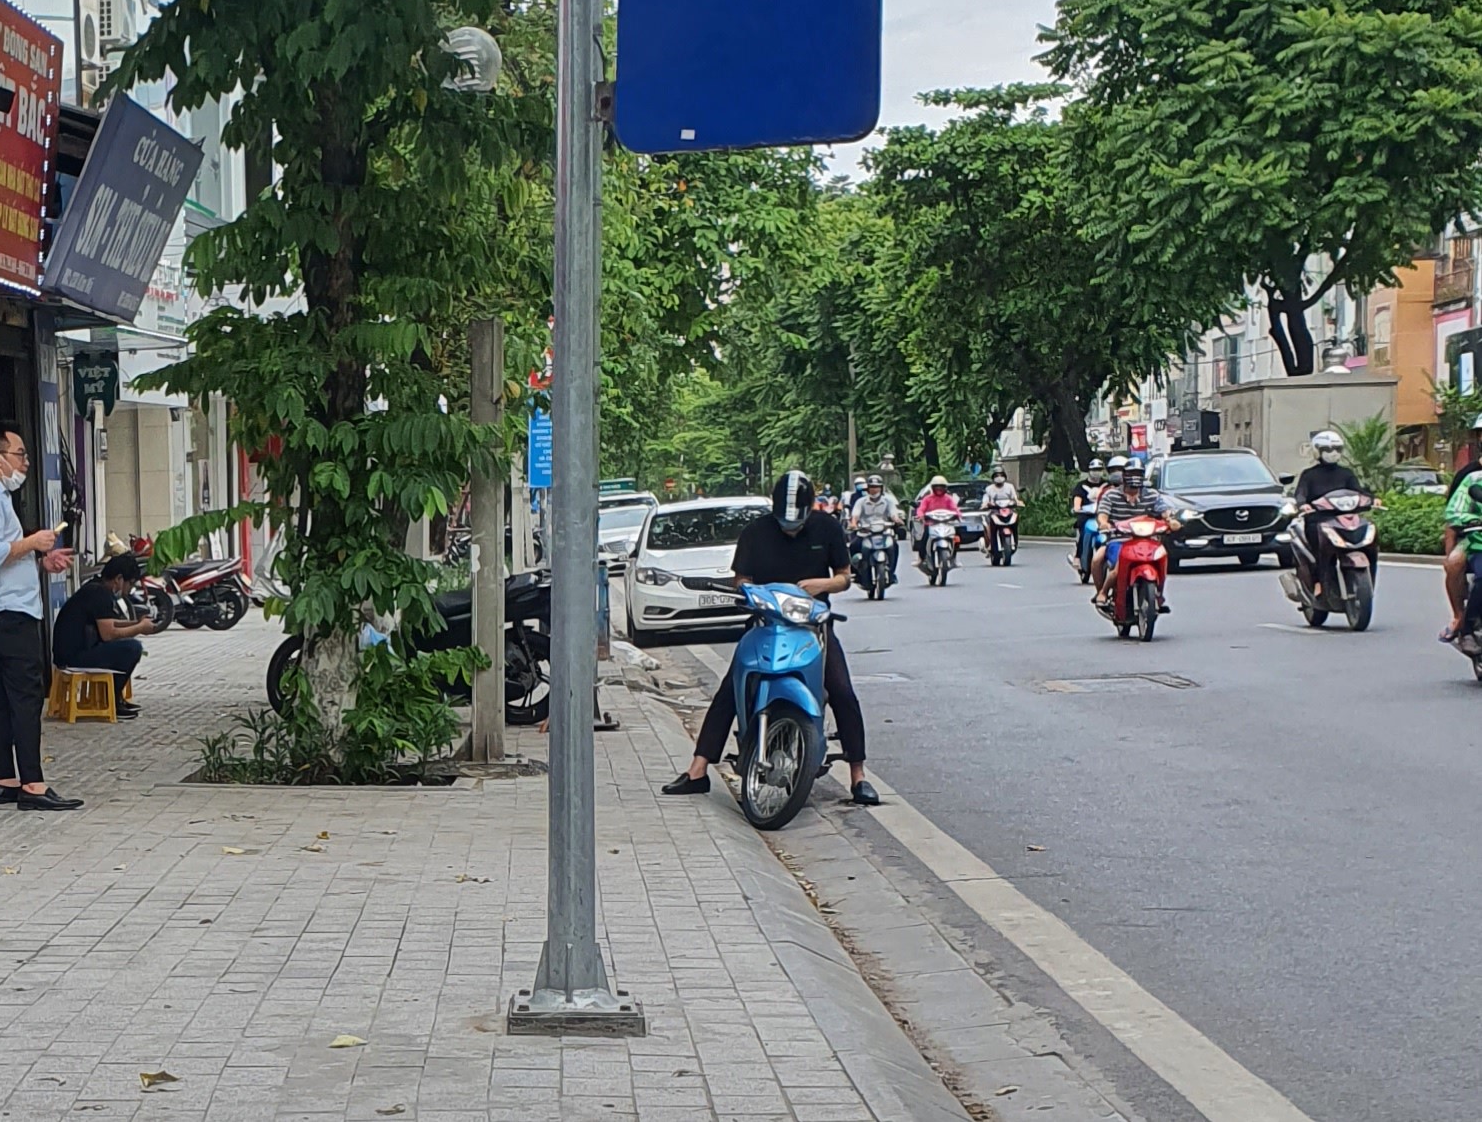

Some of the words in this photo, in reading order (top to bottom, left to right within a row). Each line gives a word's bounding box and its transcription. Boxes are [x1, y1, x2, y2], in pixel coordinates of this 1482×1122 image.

[3, 25, 29, 66] ĐỘNG
[29, 40, 49, 79] SẢN
[16, 74, 47, 146] BẮC
[132, 129, 158, 173] CỬA
[74, 183, 119, 260] SIM
